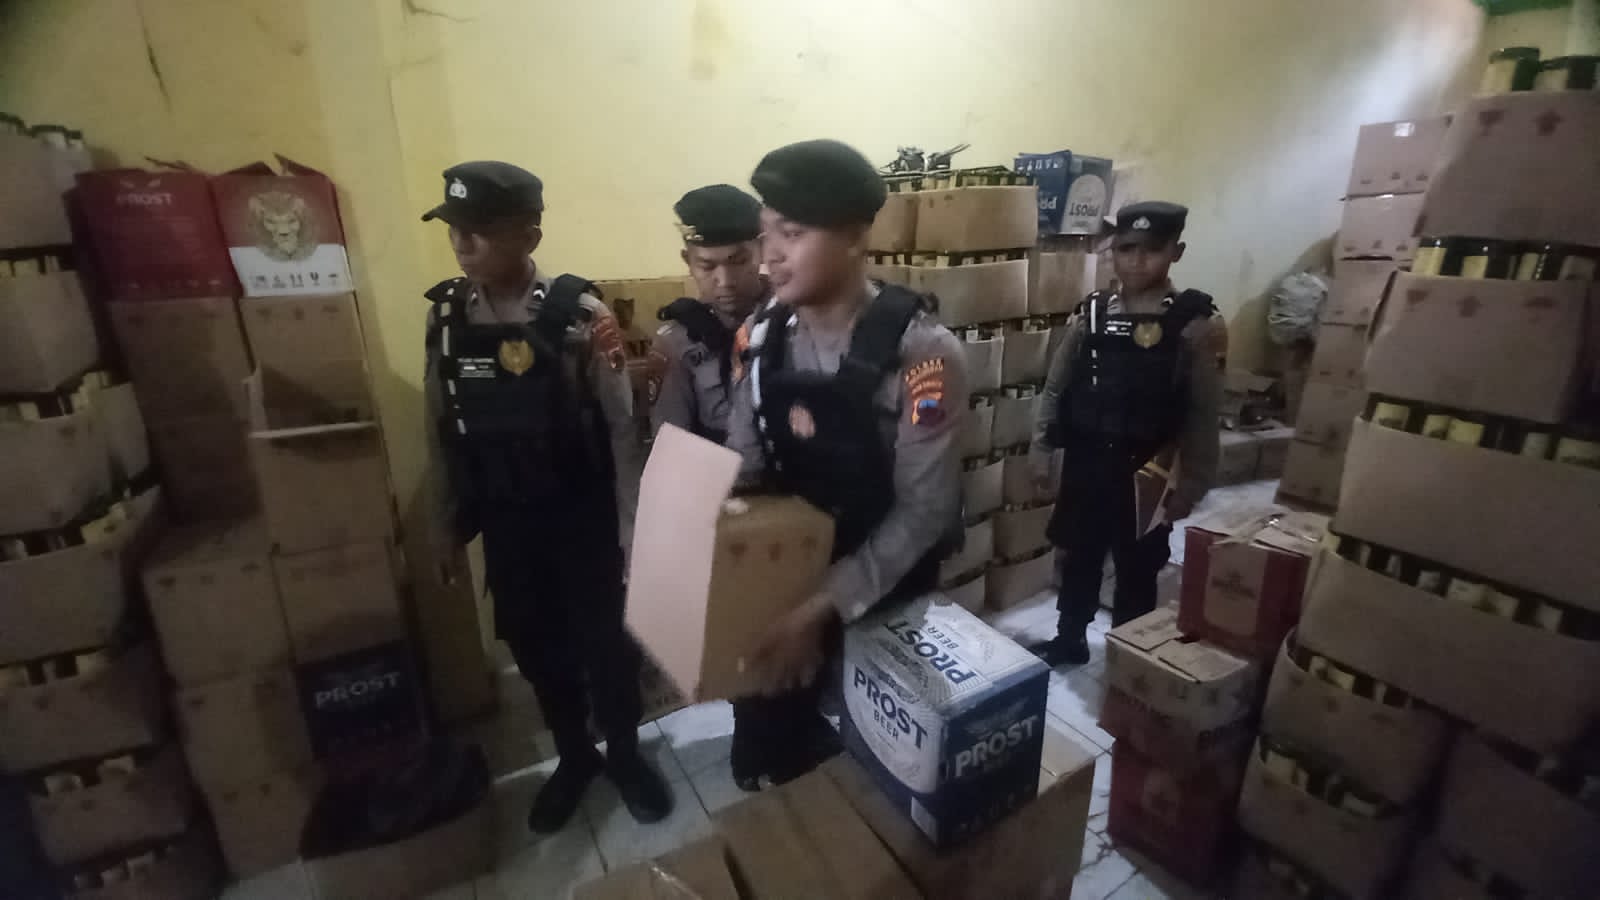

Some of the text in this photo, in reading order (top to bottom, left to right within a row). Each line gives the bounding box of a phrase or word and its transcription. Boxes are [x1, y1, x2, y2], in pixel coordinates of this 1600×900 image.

[882, 620, 978, 685] PROST
[927, 626, 960, 649] BEER
[315, 671, 400, 710] PROST
[853, 666, 929, 750] PROST
[873, 709, 900, 741] BEER
[955, 714, 1040, 778] PROST
